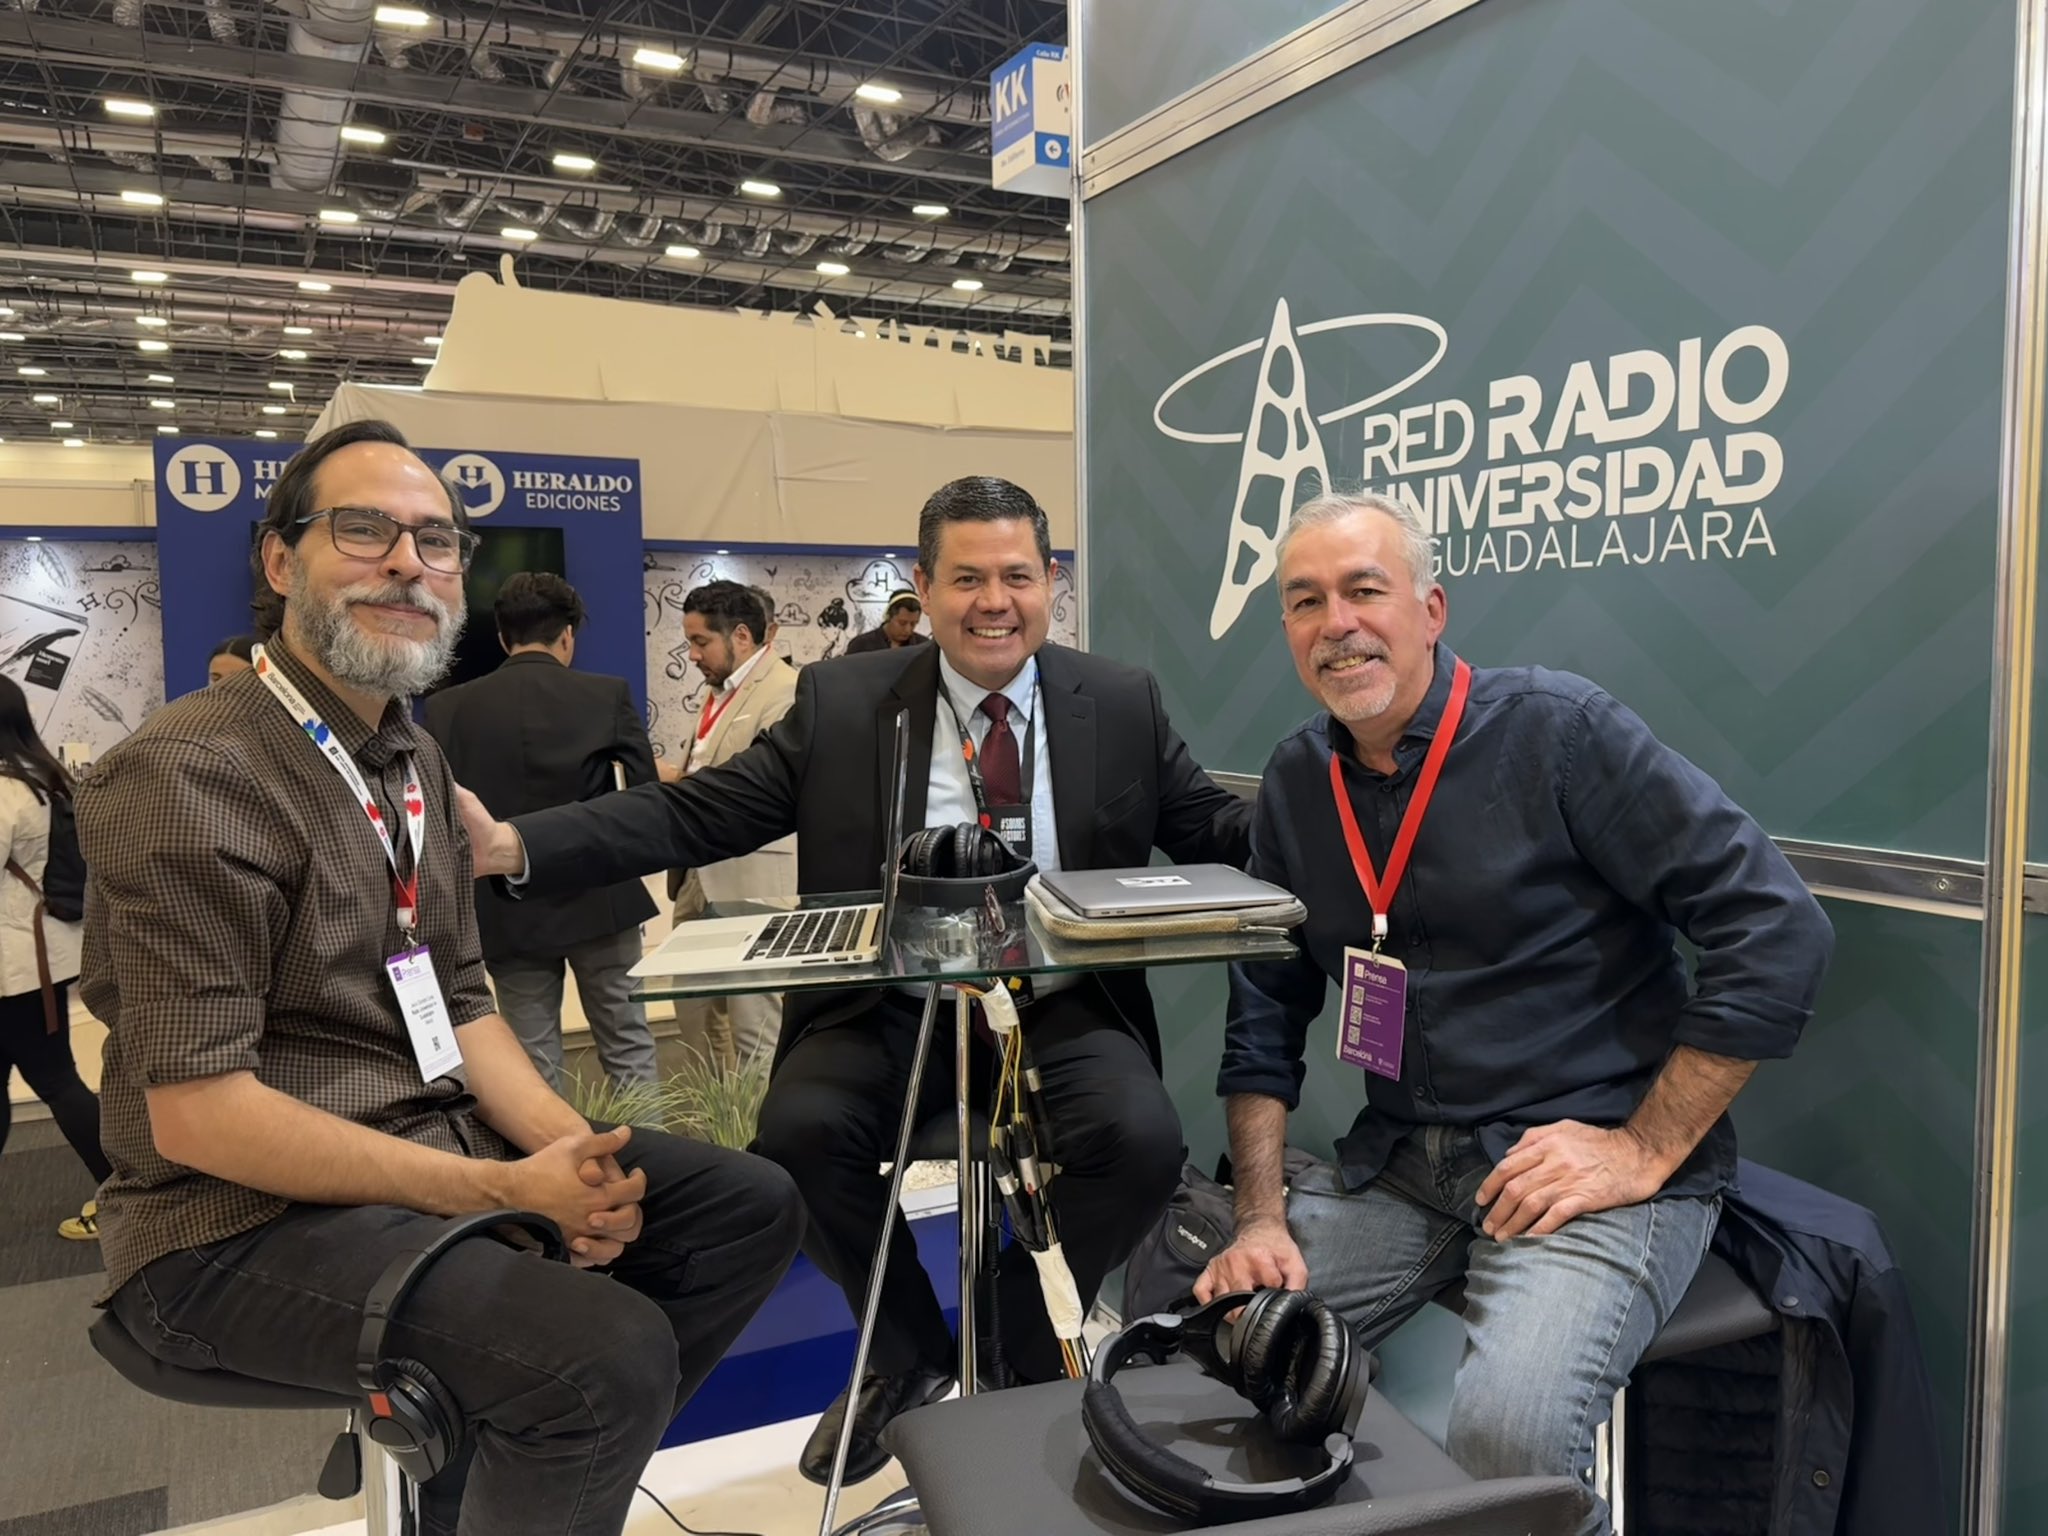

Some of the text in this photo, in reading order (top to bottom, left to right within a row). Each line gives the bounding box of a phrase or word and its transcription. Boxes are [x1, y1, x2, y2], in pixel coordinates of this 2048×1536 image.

[995, 64, 1028, 122] KK
[1363, 325, 1790, 480] RED RADIO
[180, 460, 227, 495] H
[512, 470, 633, 494] HERALDO
[1363, 431, 1784, 535] NIVERSIDAD
[526, 493, 621, 512] EDICIONES
[267, 672, 297, 707] Barcelona
[1364, 969, 1387, 985] Prensa
